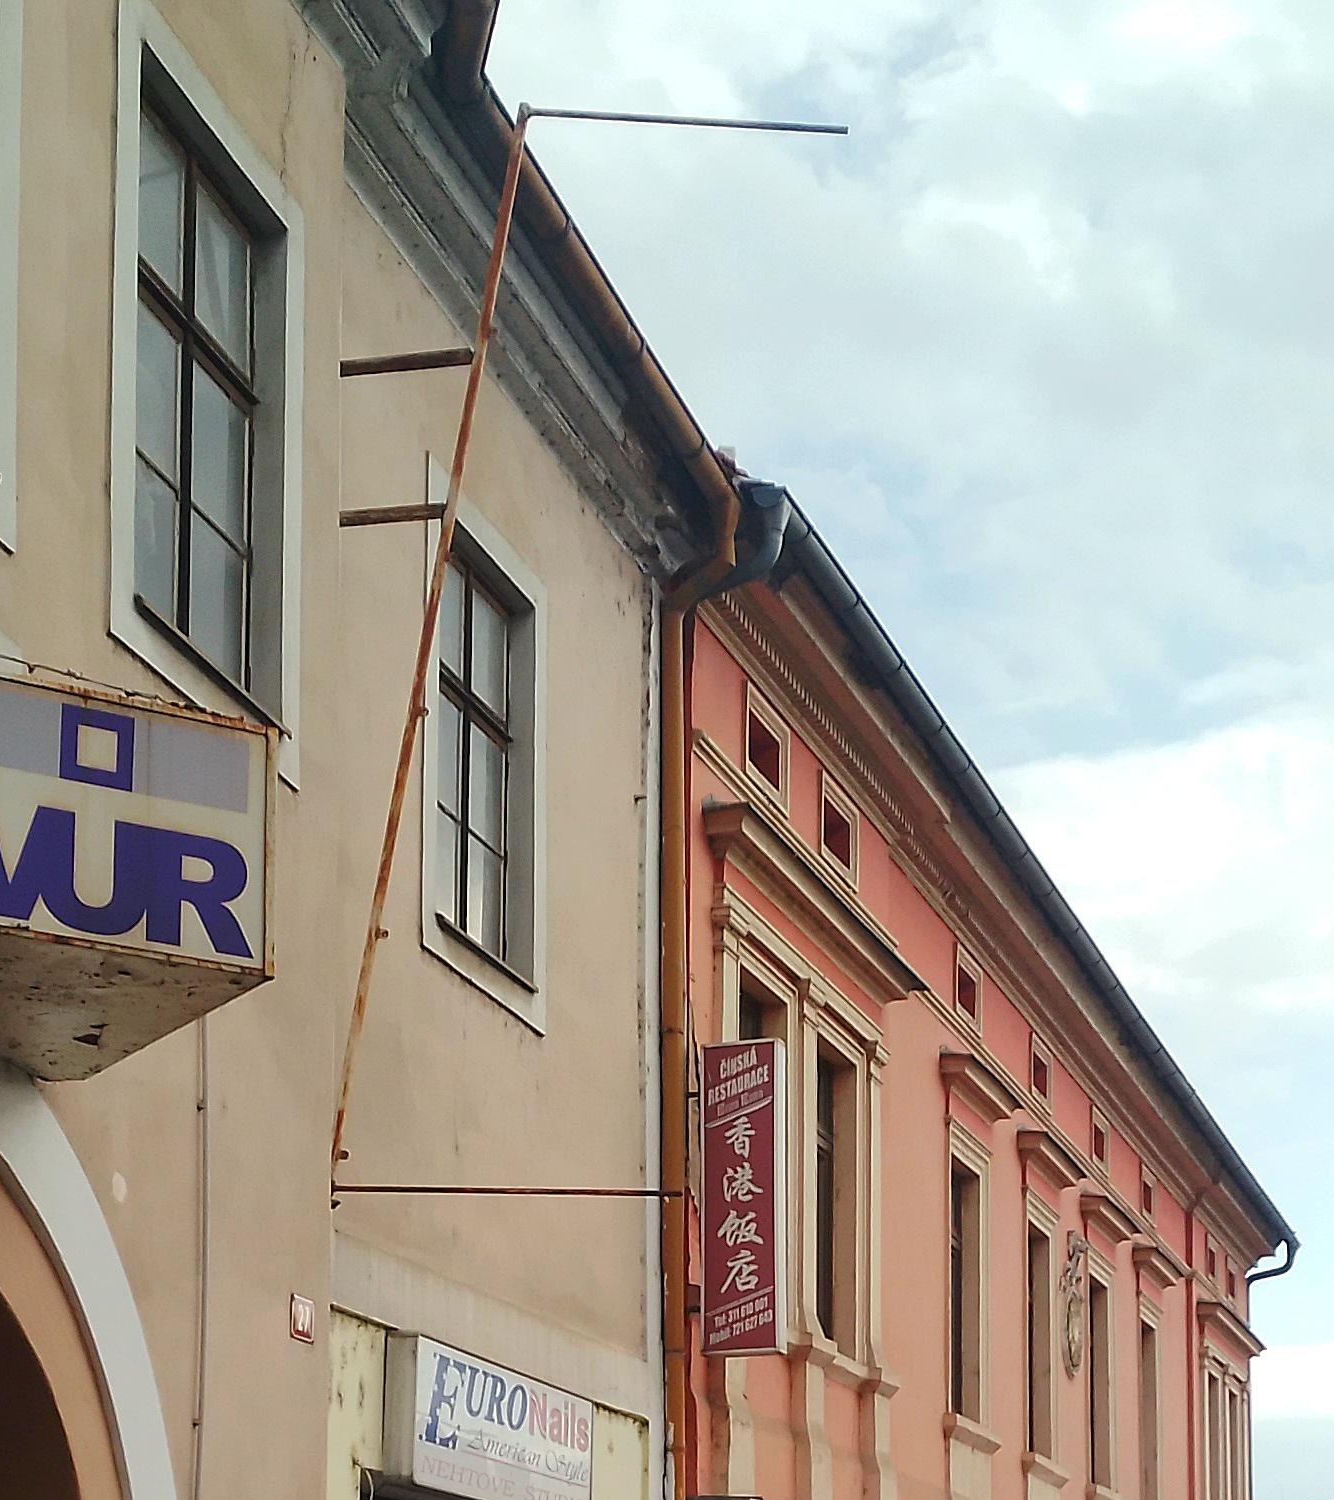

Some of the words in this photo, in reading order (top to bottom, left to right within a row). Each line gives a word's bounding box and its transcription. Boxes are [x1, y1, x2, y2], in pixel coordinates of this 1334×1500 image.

[708, 1063, 770, 1107] RESTAURACE
[467, 1430, 541, 1468] American
[545, 1450, 588, 1483] Style
